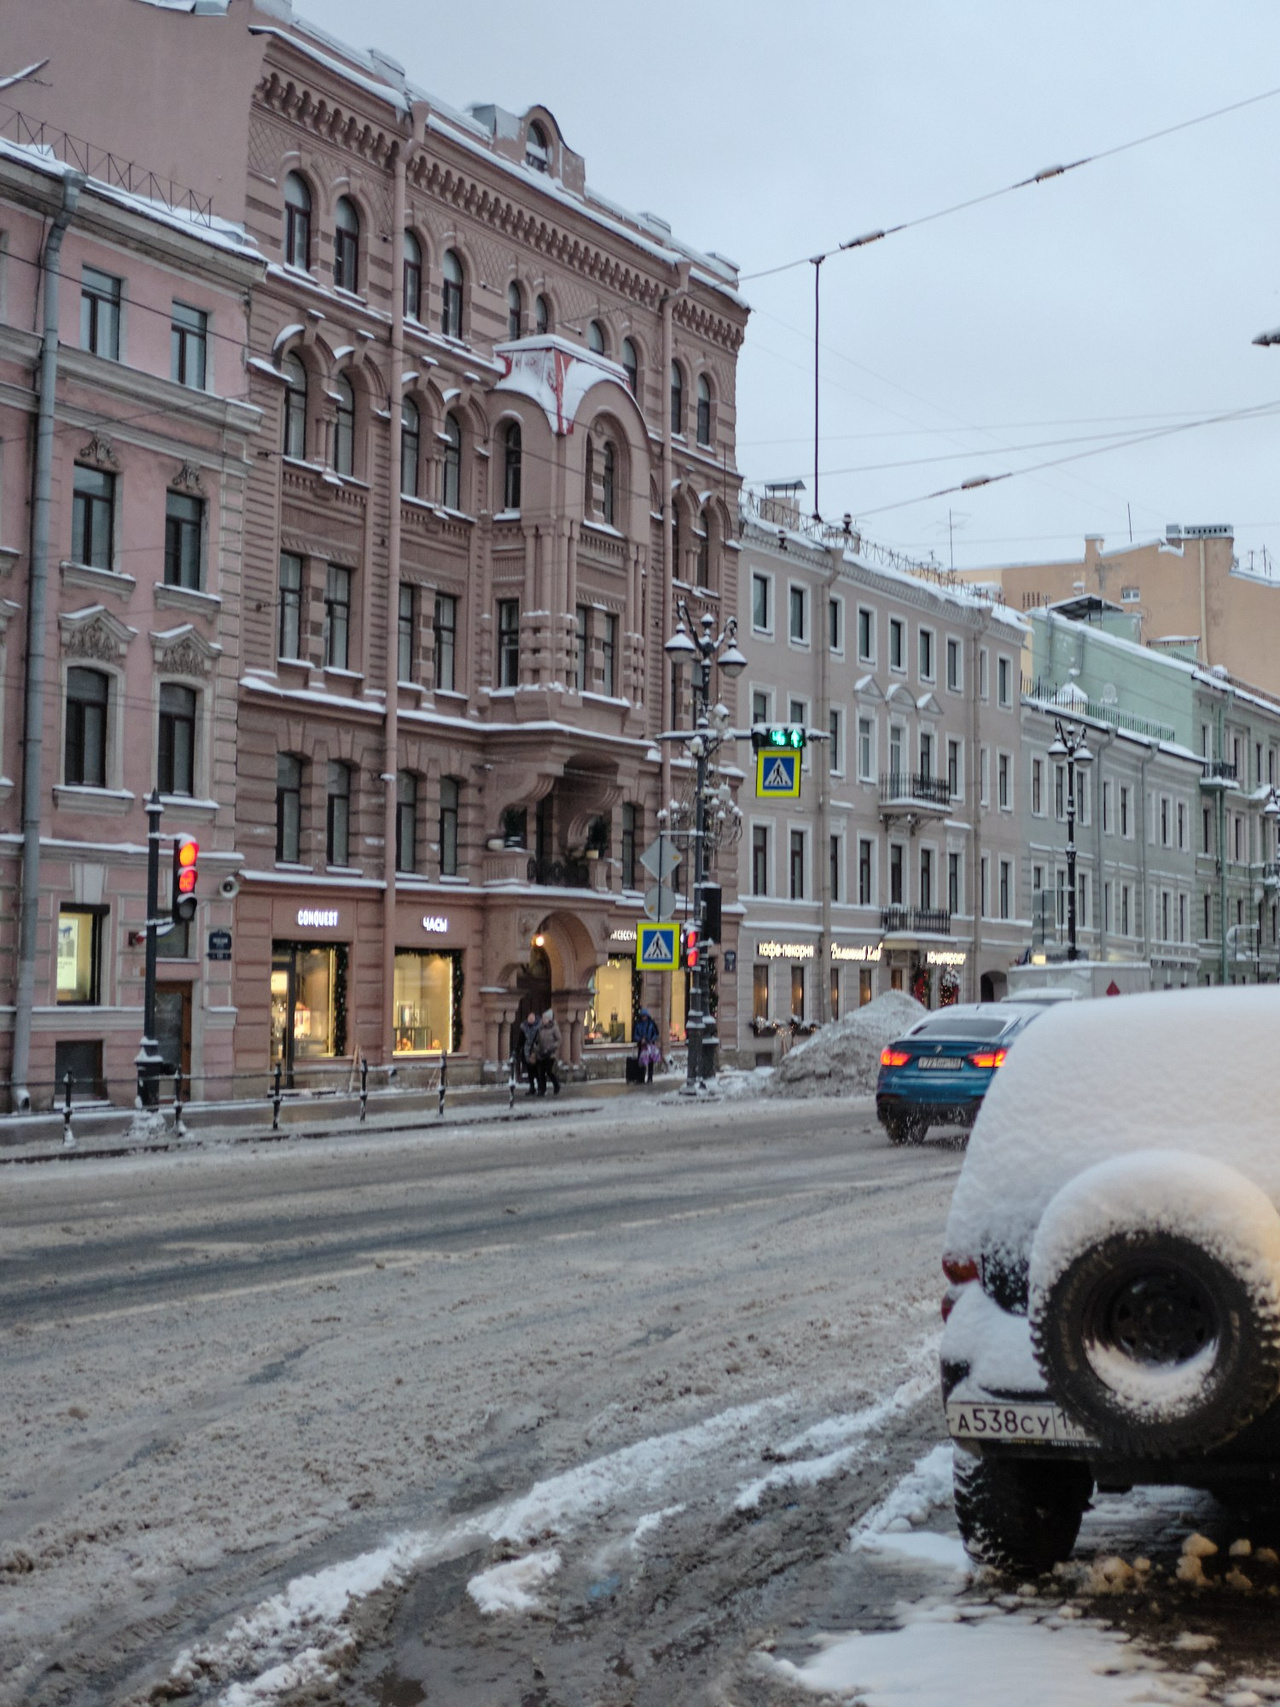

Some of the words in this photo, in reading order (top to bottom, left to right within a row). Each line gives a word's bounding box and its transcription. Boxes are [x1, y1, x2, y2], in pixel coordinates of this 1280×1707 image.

[297, 910, 339, 928] CONQUEST
[422, 916, 448, 933] ЧАСЫ
[610, 929, 637, 942] АКСЕССУА
